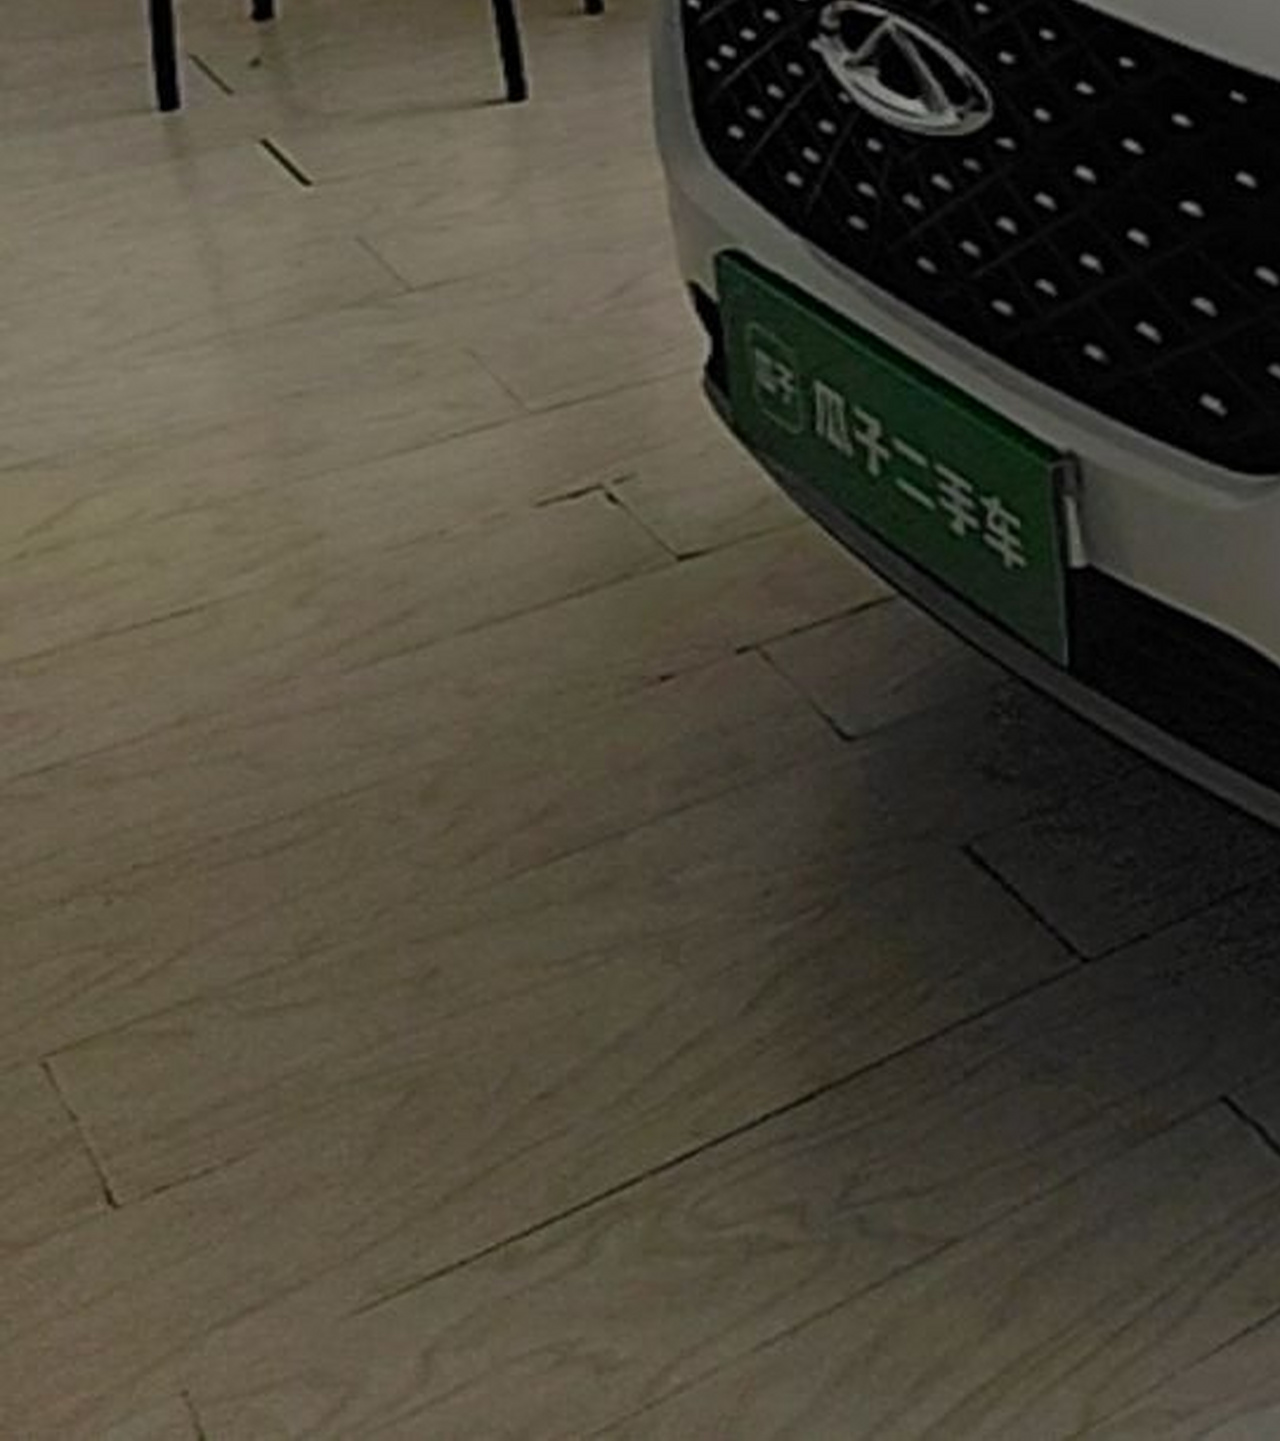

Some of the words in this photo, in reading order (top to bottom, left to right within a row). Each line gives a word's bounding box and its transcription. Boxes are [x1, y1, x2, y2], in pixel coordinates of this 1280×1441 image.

[812, 379, 1028, 569] 瓜子二手车
